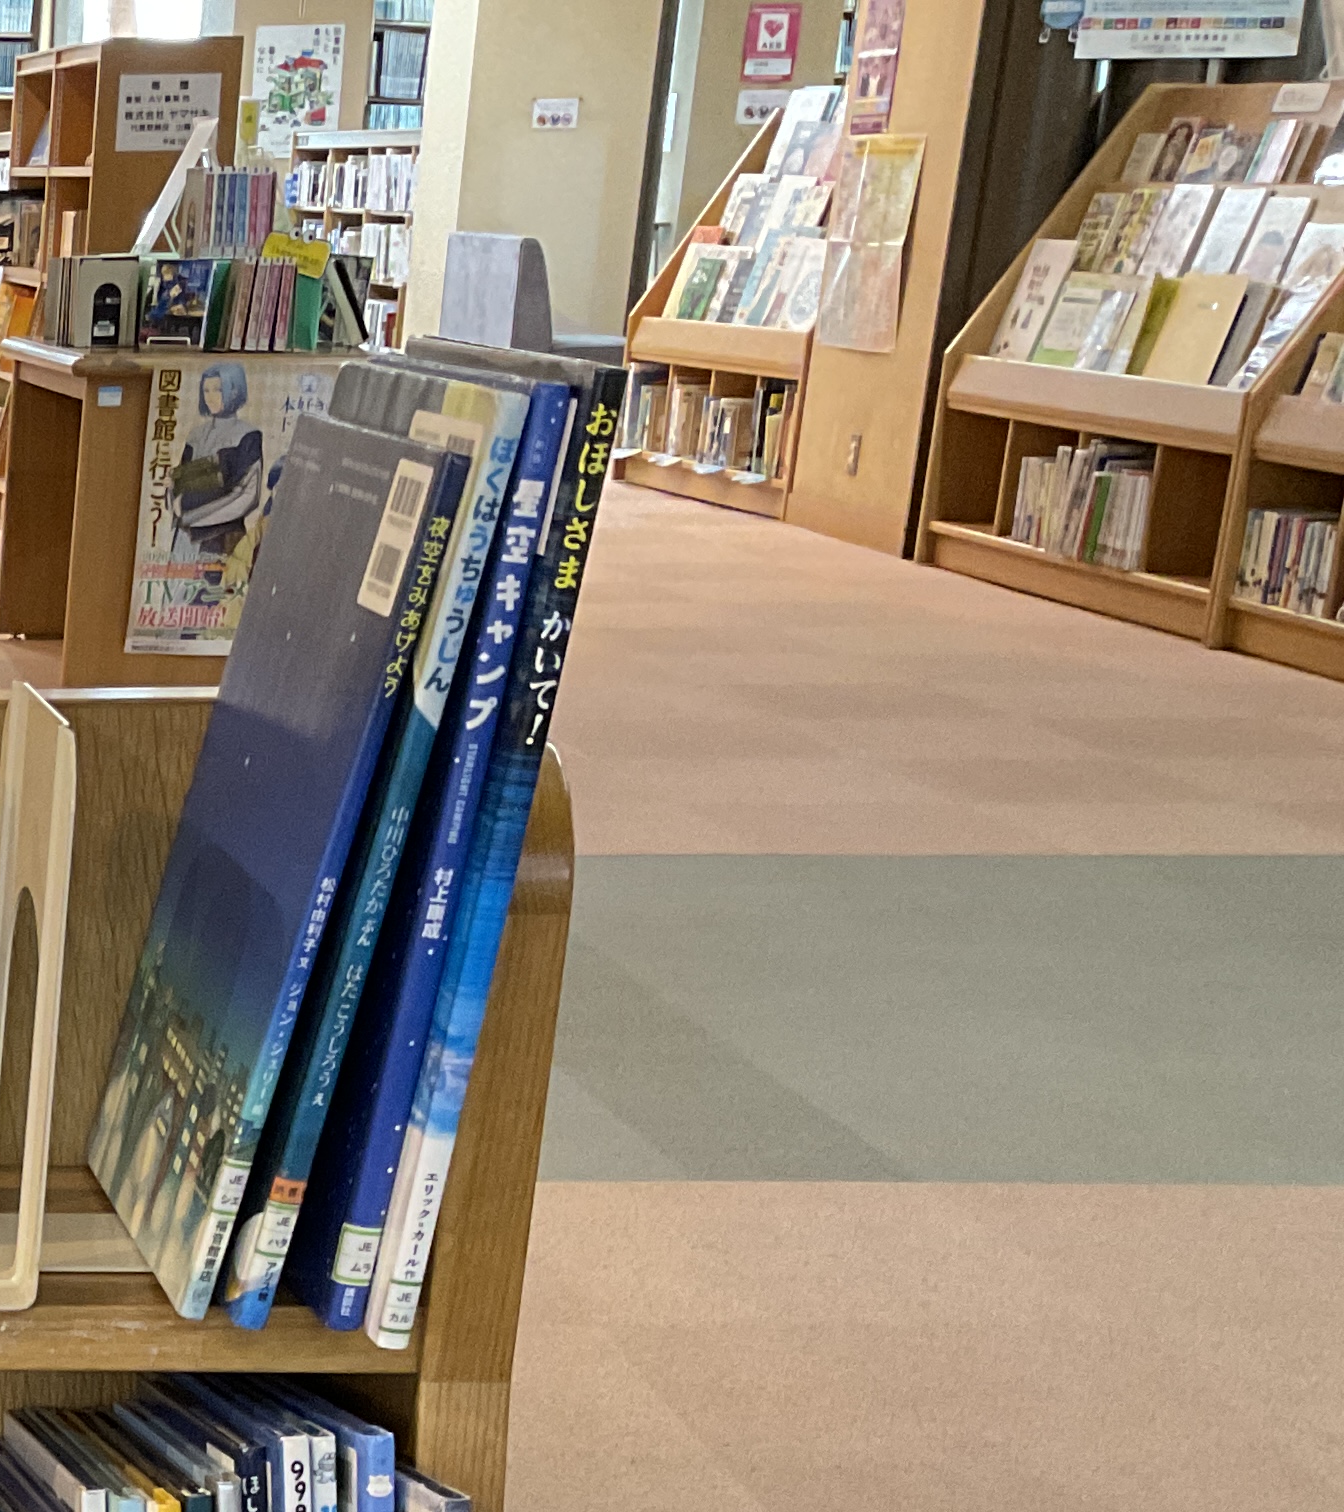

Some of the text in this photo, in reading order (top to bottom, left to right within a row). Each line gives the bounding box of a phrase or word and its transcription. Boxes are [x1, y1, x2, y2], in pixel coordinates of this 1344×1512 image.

[424, 436, 518, 696] ぼくはうちゅうじん
[552, 402, 620, 589] おほしさま
[385, 515, 452, 699] 夜空をみあげよう
[465, 478, 546, 731] 星空キャンプ
[229, 1175, 244, 1185] JE
[358, 1242, 373, 1253] JE
